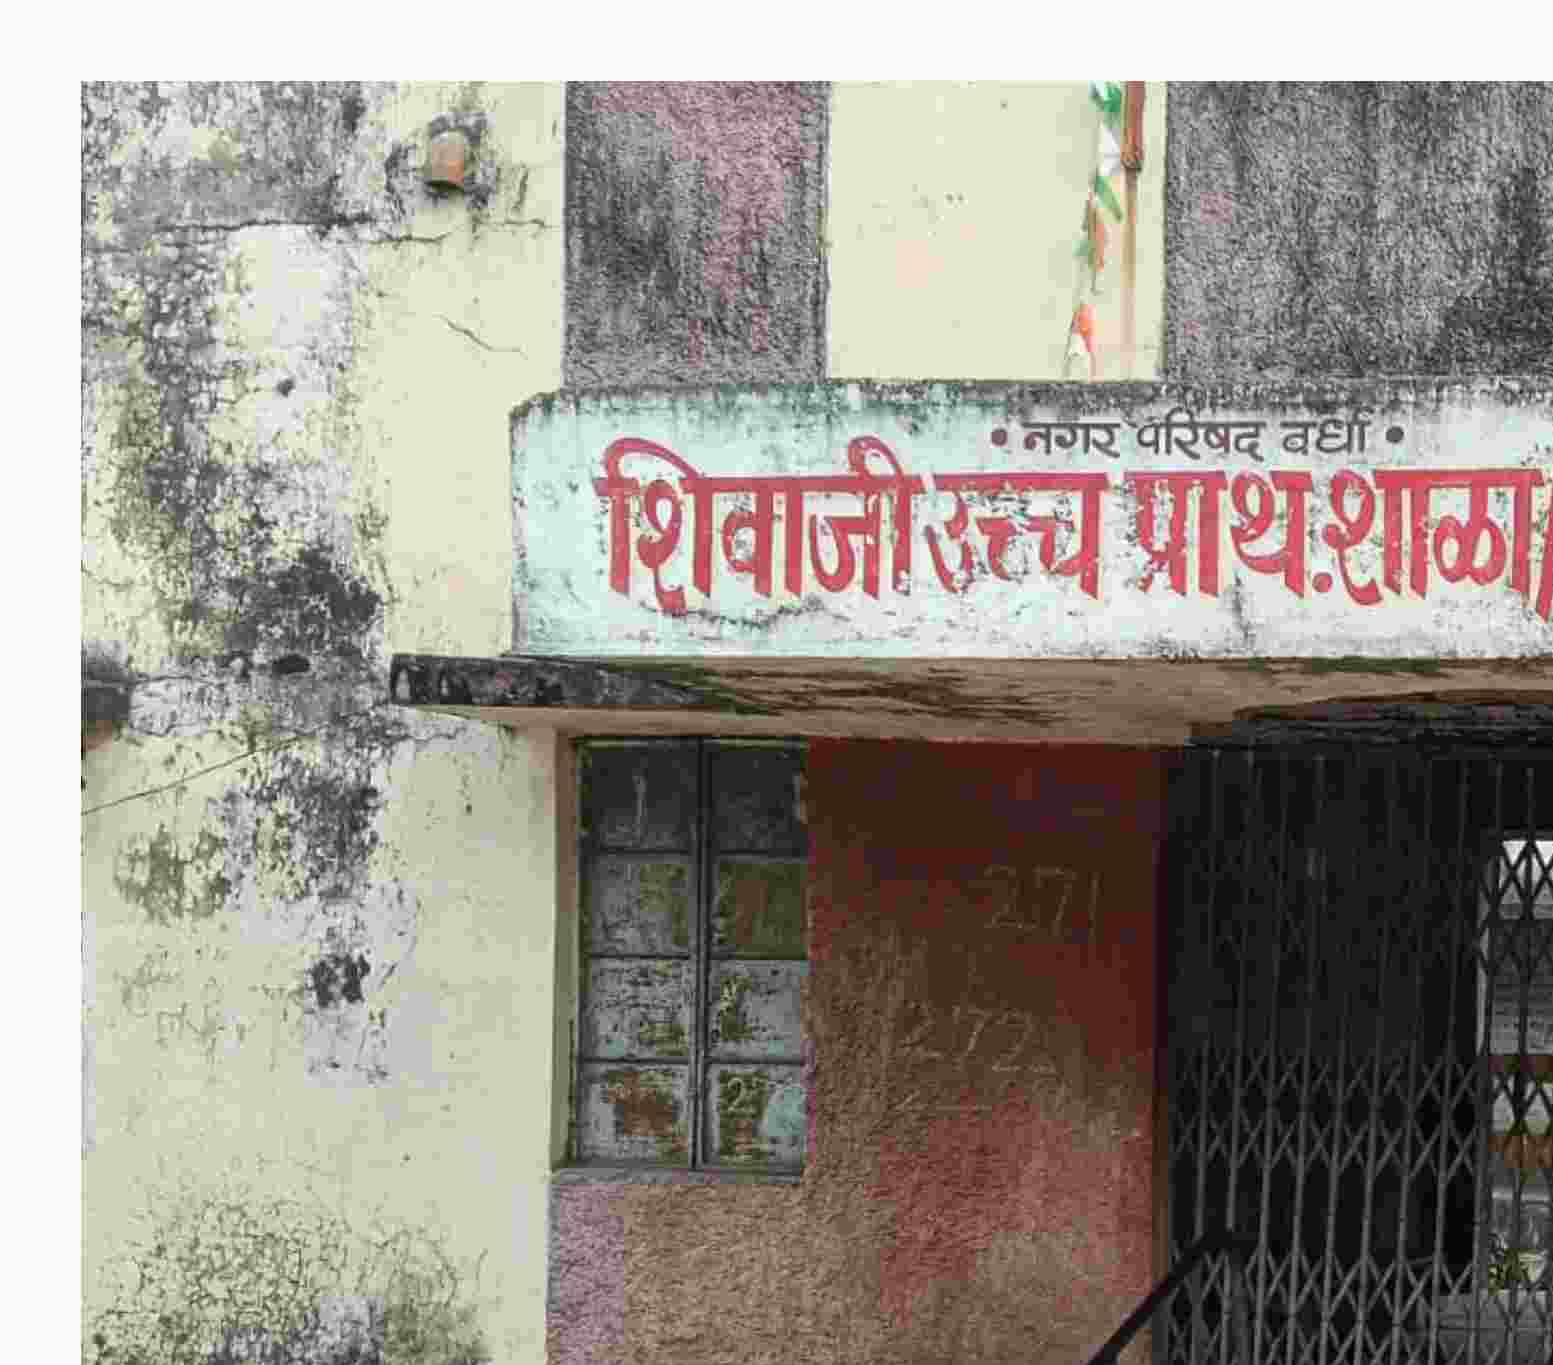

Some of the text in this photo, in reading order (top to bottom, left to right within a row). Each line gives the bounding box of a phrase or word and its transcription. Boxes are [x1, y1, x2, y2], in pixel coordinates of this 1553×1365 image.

[1022, 408, 1376, 461] नगर परिषद वर्धा
[593, 435, 925, 616] शिवाजी
